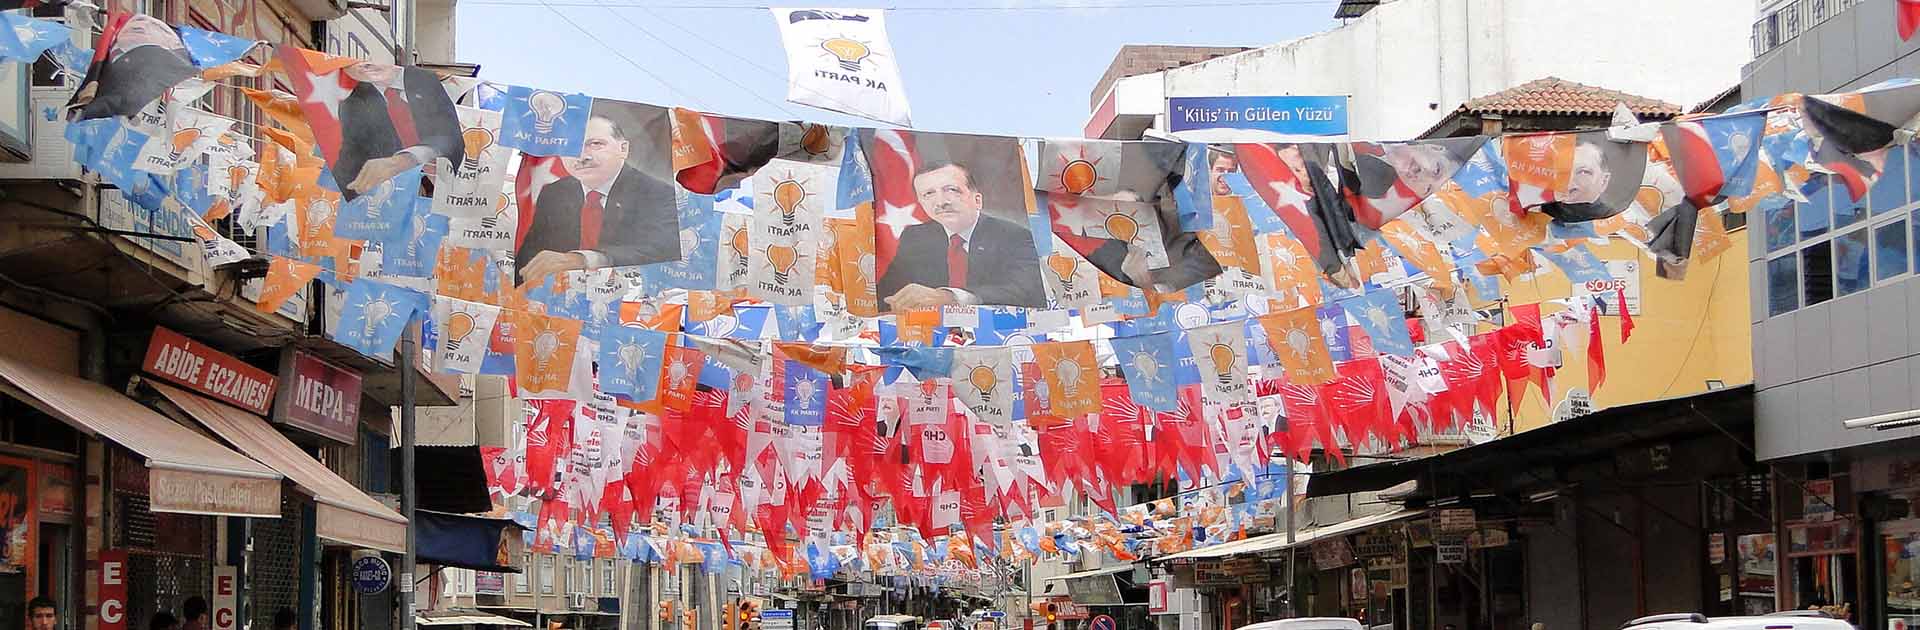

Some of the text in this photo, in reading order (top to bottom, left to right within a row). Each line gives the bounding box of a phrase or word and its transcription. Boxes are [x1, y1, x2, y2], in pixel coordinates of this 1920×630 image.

[1244, 106, 1290, 121] Gülen
[514, 131, 532, 141] AK
[154, 337, 273, 411] ABİDE ECZANESİ
[295, 373, 344, 423] MEPA
